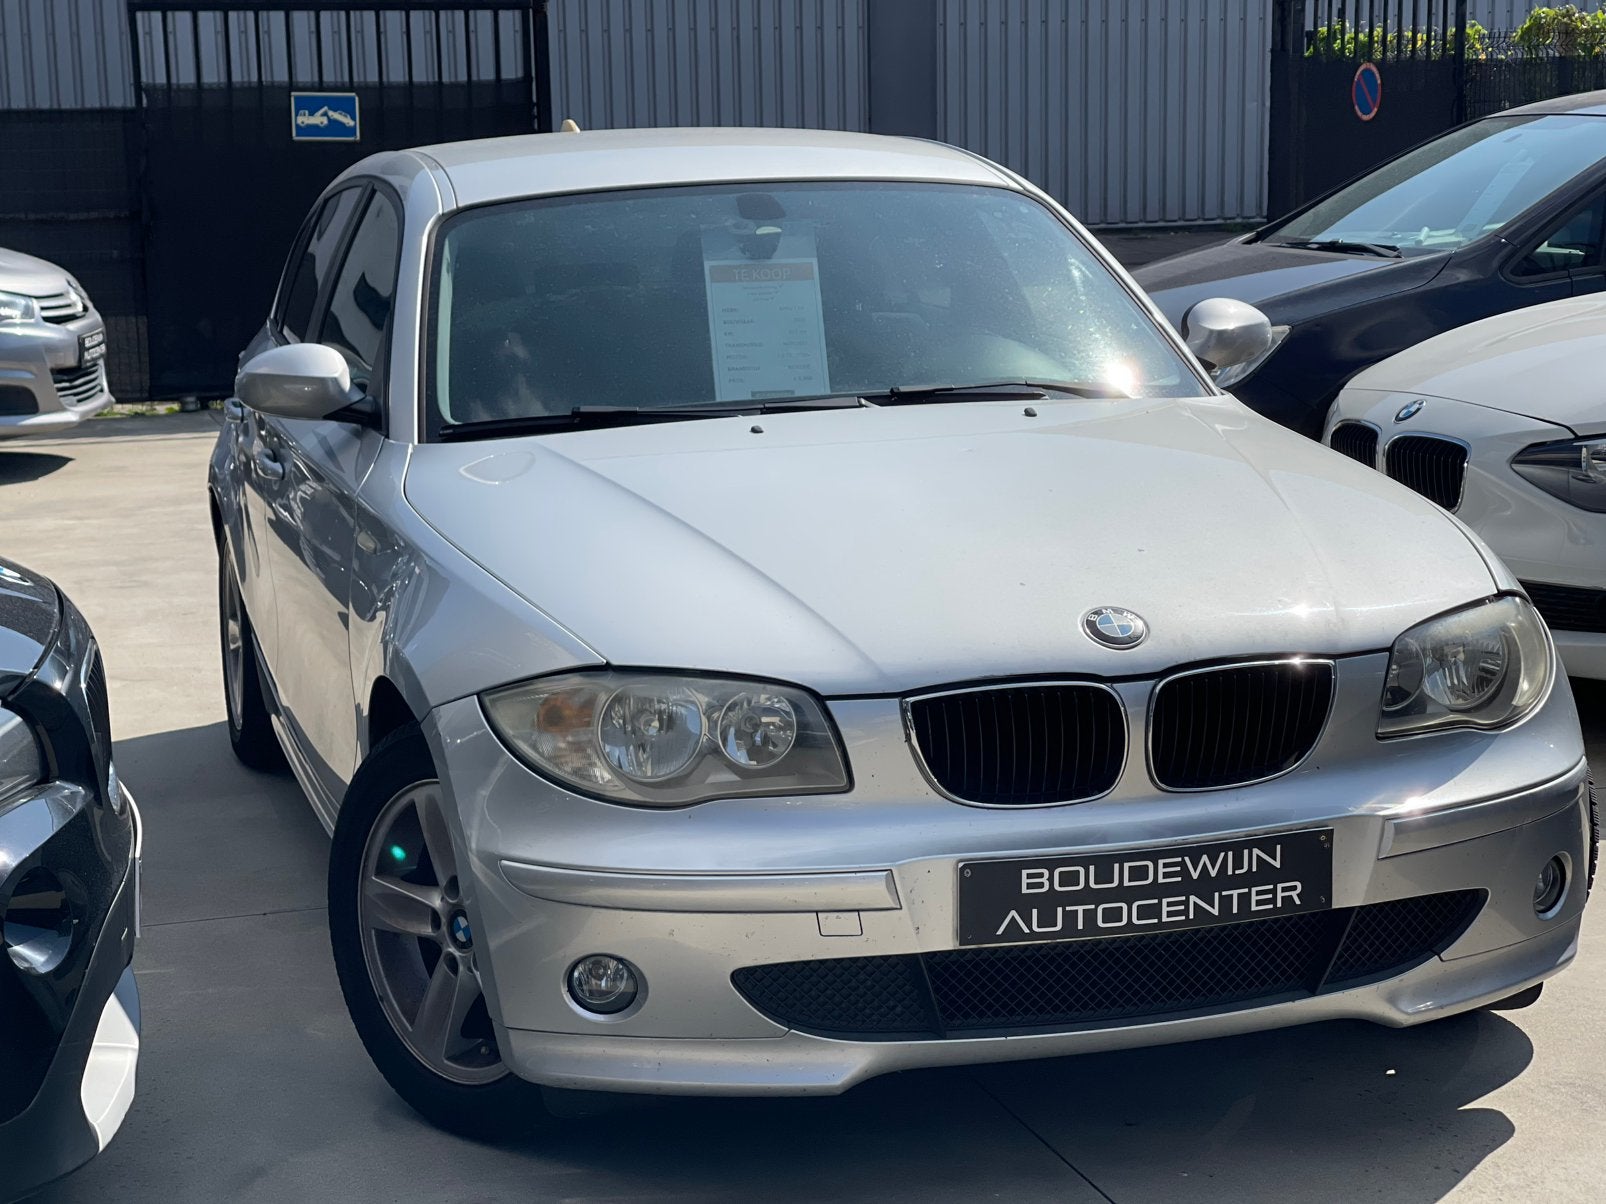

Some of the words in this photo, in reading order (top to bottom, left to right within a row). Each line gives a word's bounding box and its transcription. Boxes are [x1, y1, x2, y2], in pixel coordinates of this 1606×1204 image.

[732, 268, 749, 281] TE
[752, 267, 790, 281] KOOP
[1087, 607, 1136, 622] BMW
[1020, 844, 1281, 894] BOUDEWIJN
[995, 881, 1302, 935] AUTOCENTER
